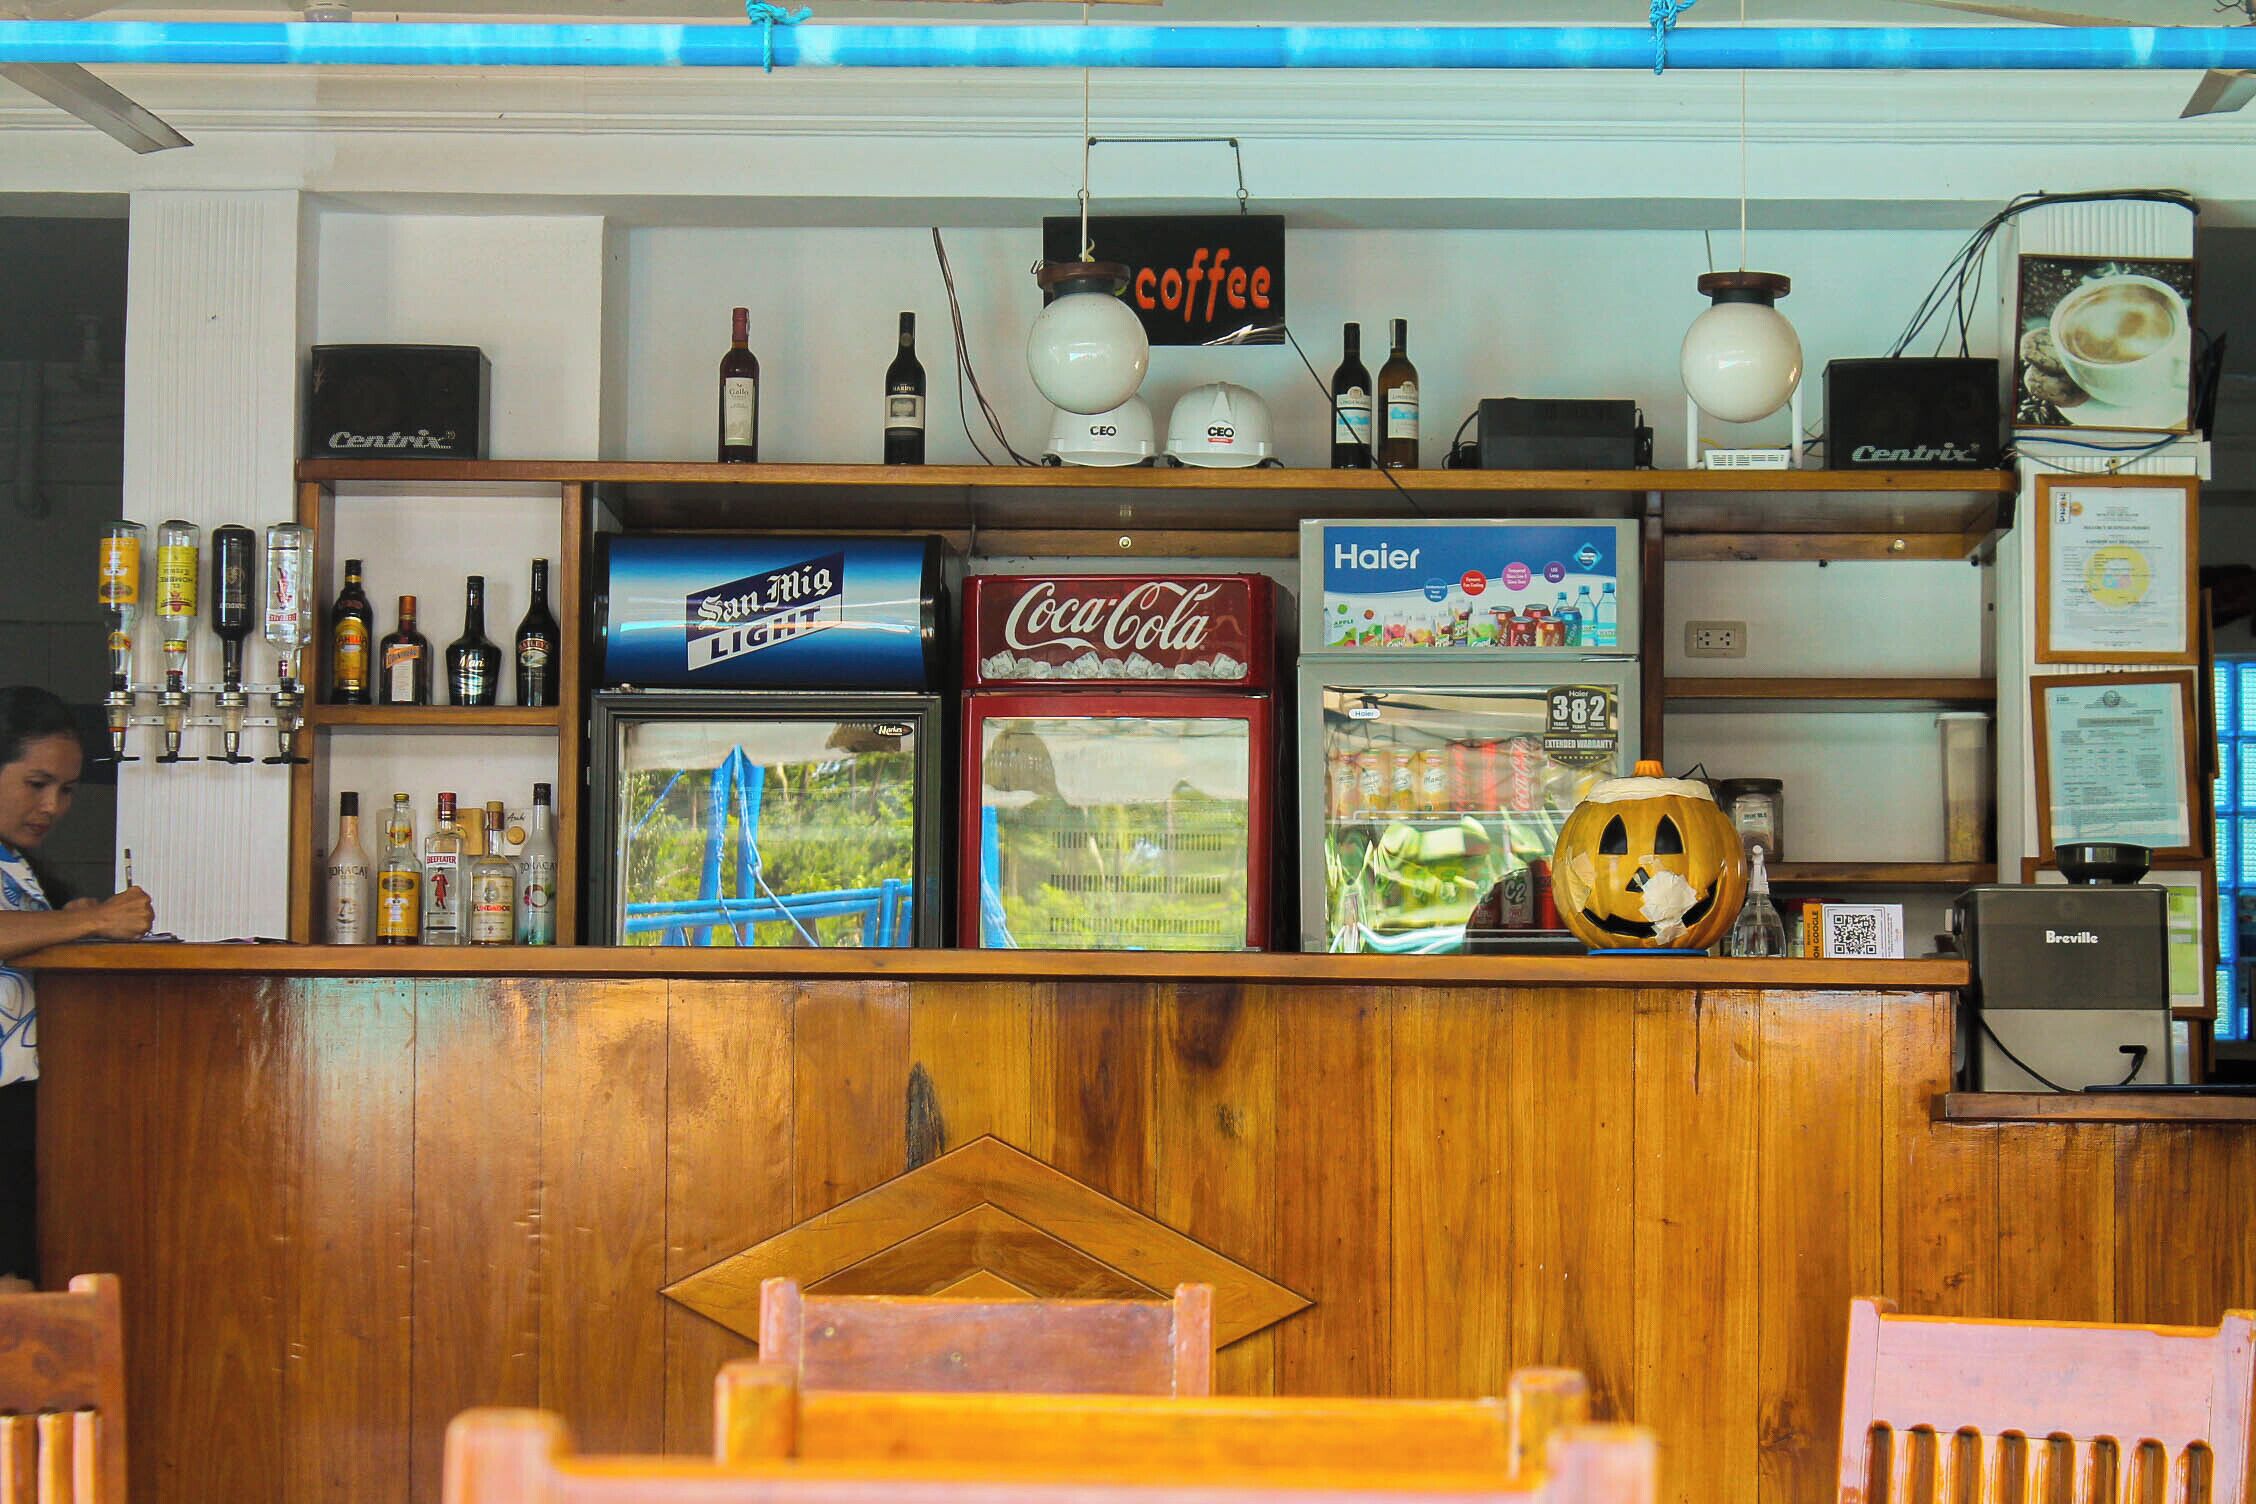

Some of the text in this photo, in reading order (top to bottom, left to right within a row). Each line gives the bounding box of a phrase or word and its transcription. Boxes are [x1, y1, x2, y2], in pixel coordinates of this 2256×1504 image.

[1135, 247, 1271, 323] coffee
[729, 388, 749, 396] Gallo
[328, 429, 452, 449] Centrix
[1090, 425, 1117, 437] CEO
[1207, 426, 1235, 438] CEO
[1851, 442, 1977, 462] Centrix
[1334, 542, 1421, 570] Haier
[697, 564, 833, 631] San Mig
[1004, 581, 1223, 651] Coca-Cola
[710, 604, 821, 660] LIGHT
[1568, 689, 1589, 697] Haier
[1544, 739, 1613, 749] EXTENDED WARRANTY
[426, 855, 456, 864] BEEFEATER
[1504, 878, 1527, 901] C2
[473, 904, 511, 913] FUNDADOR
[1812, 910, 1820, 938] GOOGLE
[2046, 930, 2099, 944] Breville
